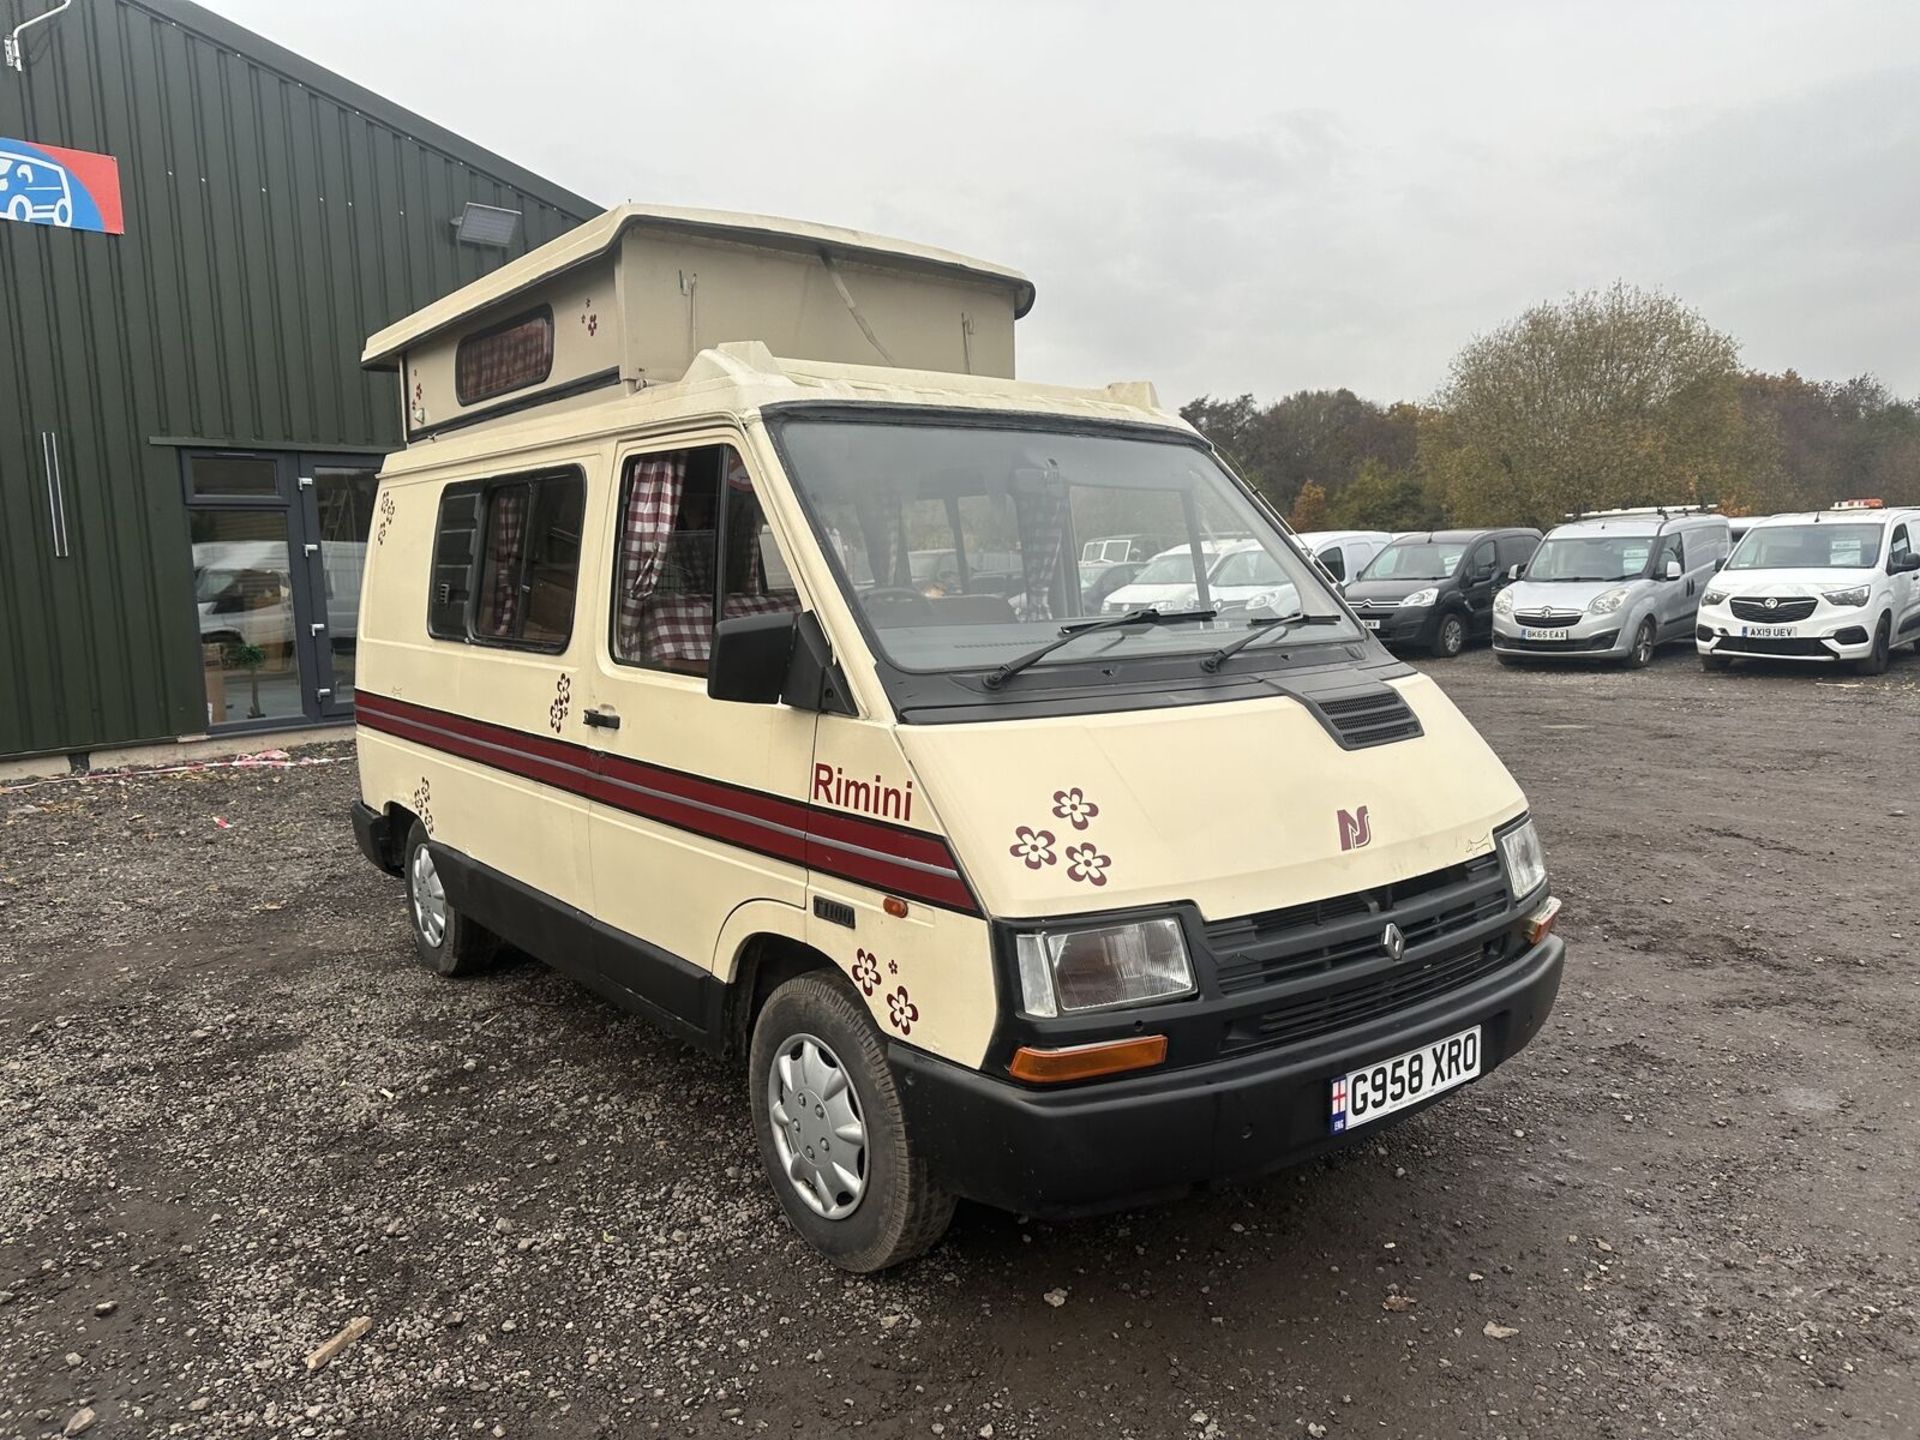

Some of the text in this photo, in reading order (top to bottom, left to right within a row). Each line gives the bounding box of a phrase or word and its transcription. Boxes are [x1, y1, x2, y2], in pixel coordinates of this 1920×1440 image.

[1750, 628, 1793, 636] AX19 UEV
[813, 762, 913, 822] Rimini
[1351, 1032, 1477, 1117] G958 XRO
